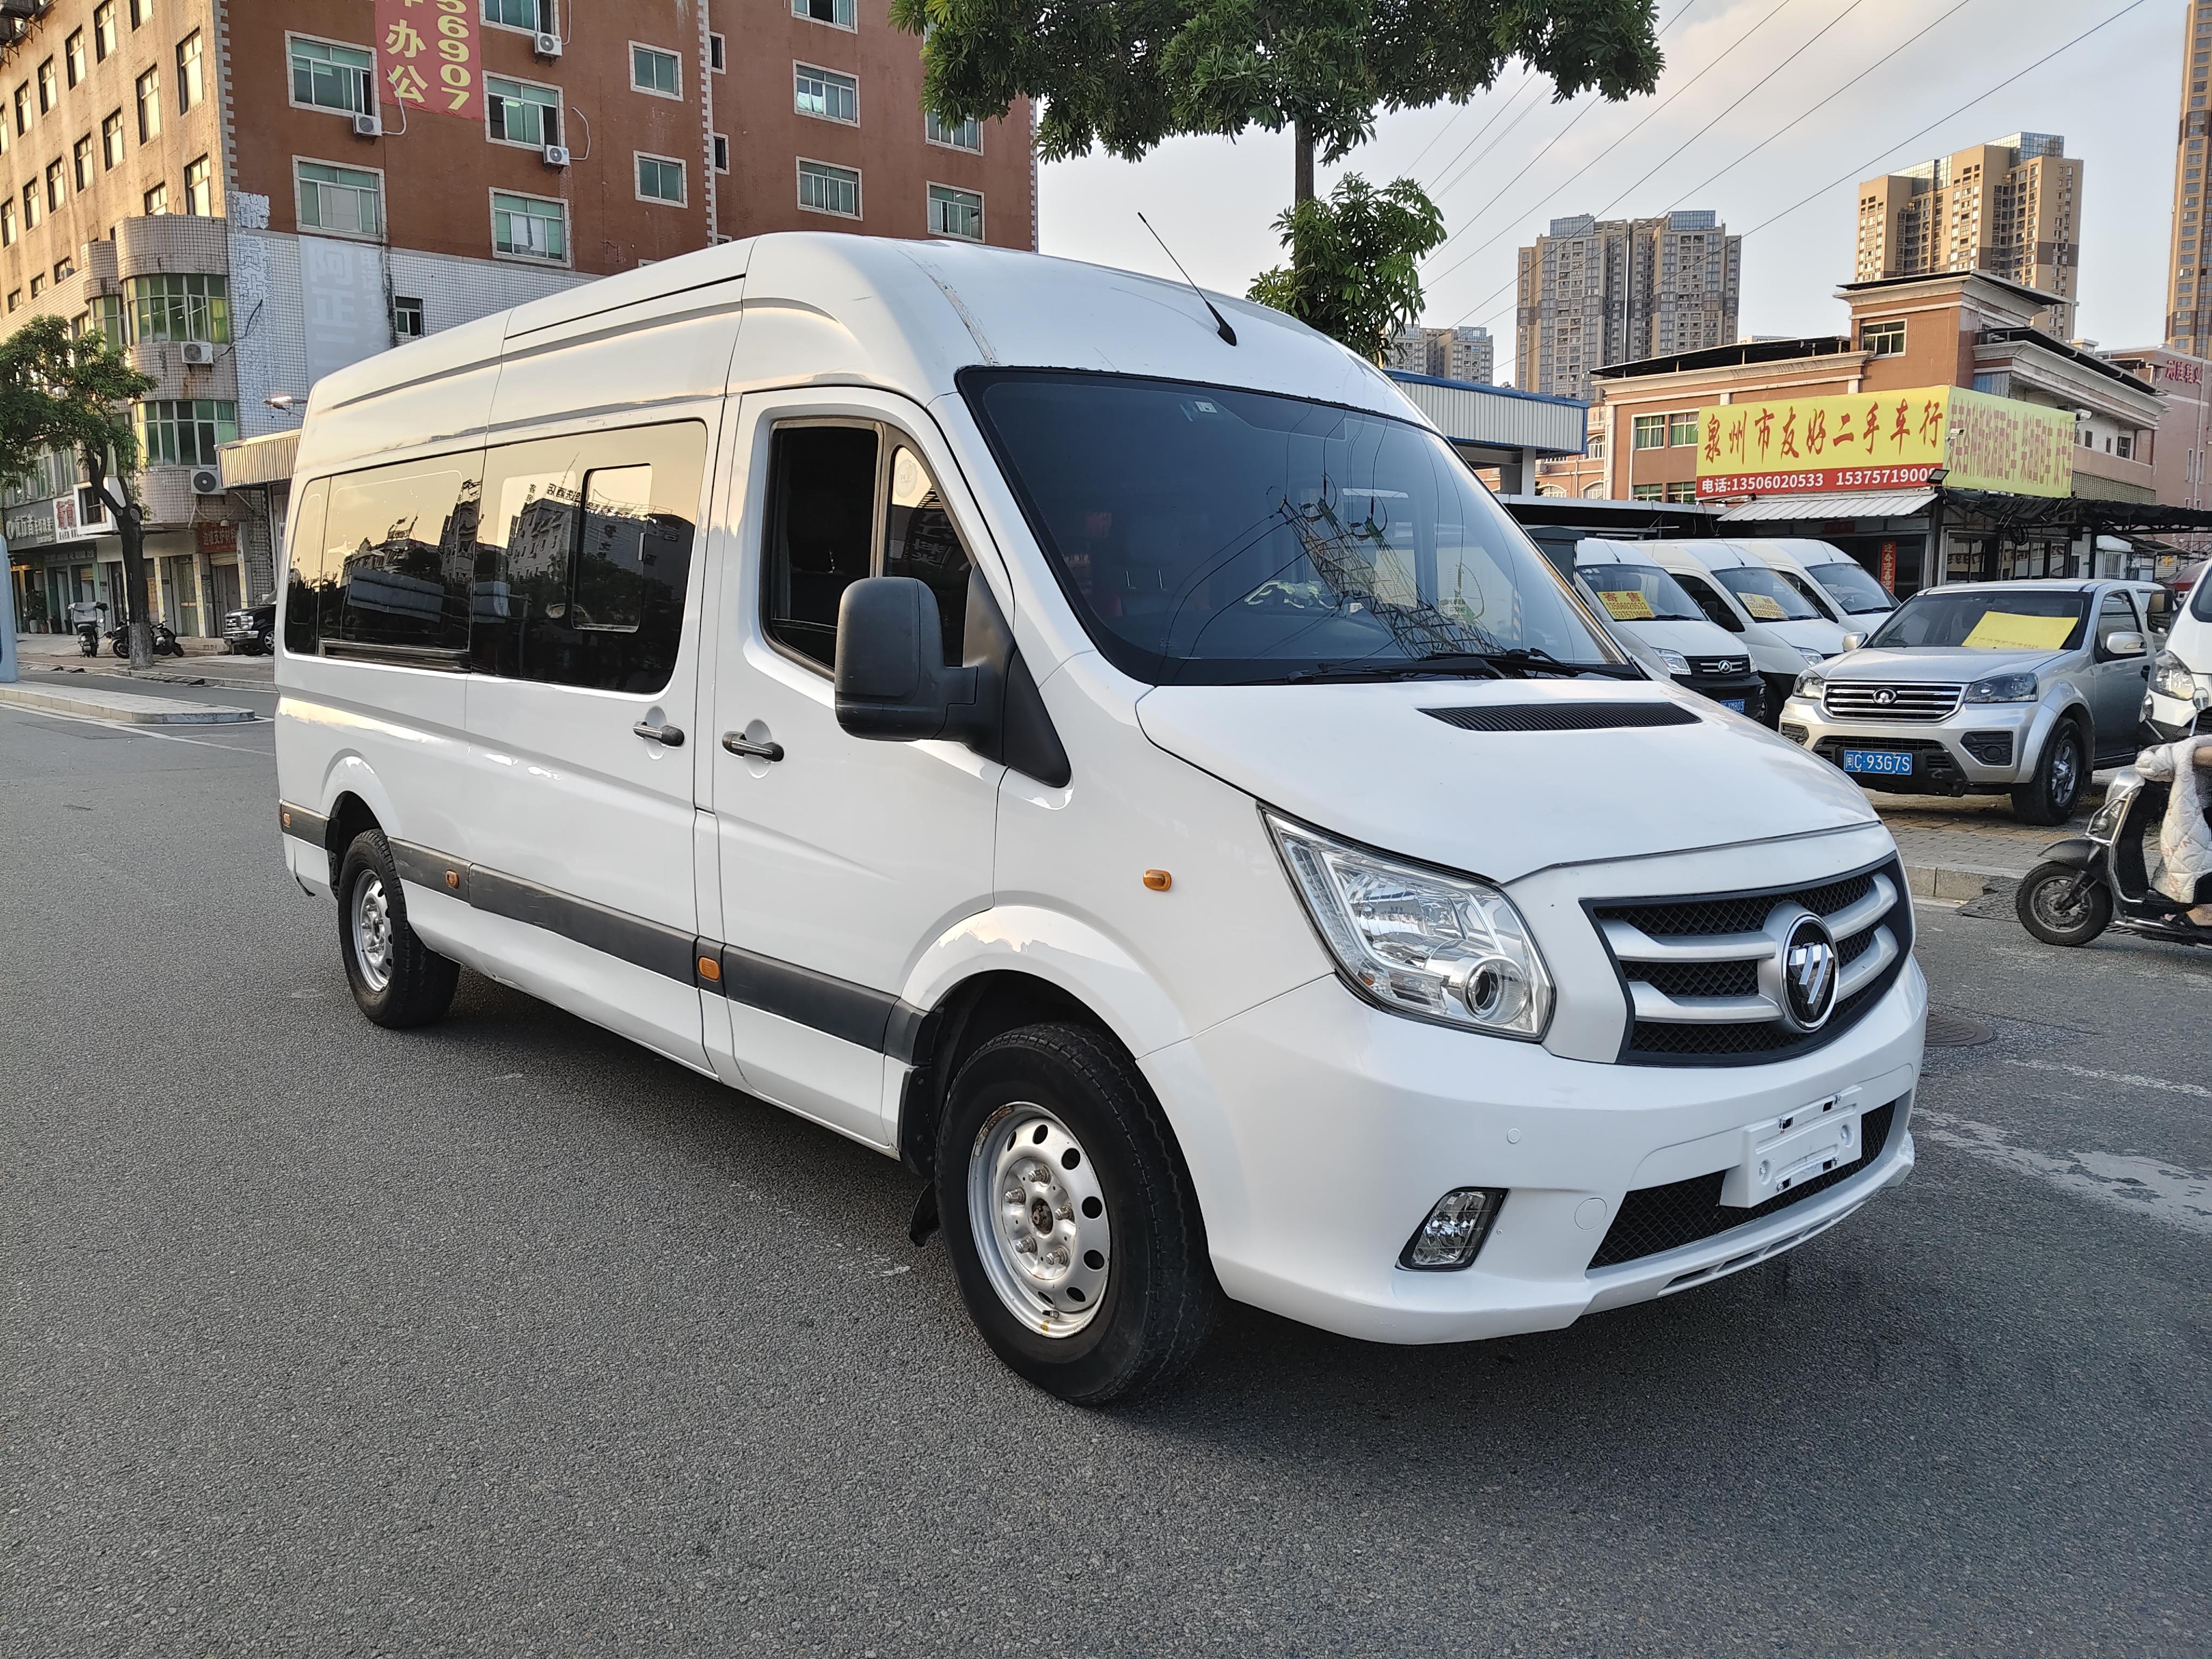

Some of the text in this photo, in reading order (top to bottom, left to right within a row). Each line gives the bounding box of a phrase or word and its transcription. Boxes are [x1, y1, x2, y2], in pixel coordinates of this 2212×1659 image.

[385, 0, 428, 103] 办公
[1704, 398, 1944, 464] 泉州市友好二手车行
[2020, 412, 2053, 487] 柴油面包车
[2054, 419, 2075, 489] 皮卡车
[1606, 602, 1648, 610] 13506020533
[1626, 592, 1641, 602] 售
